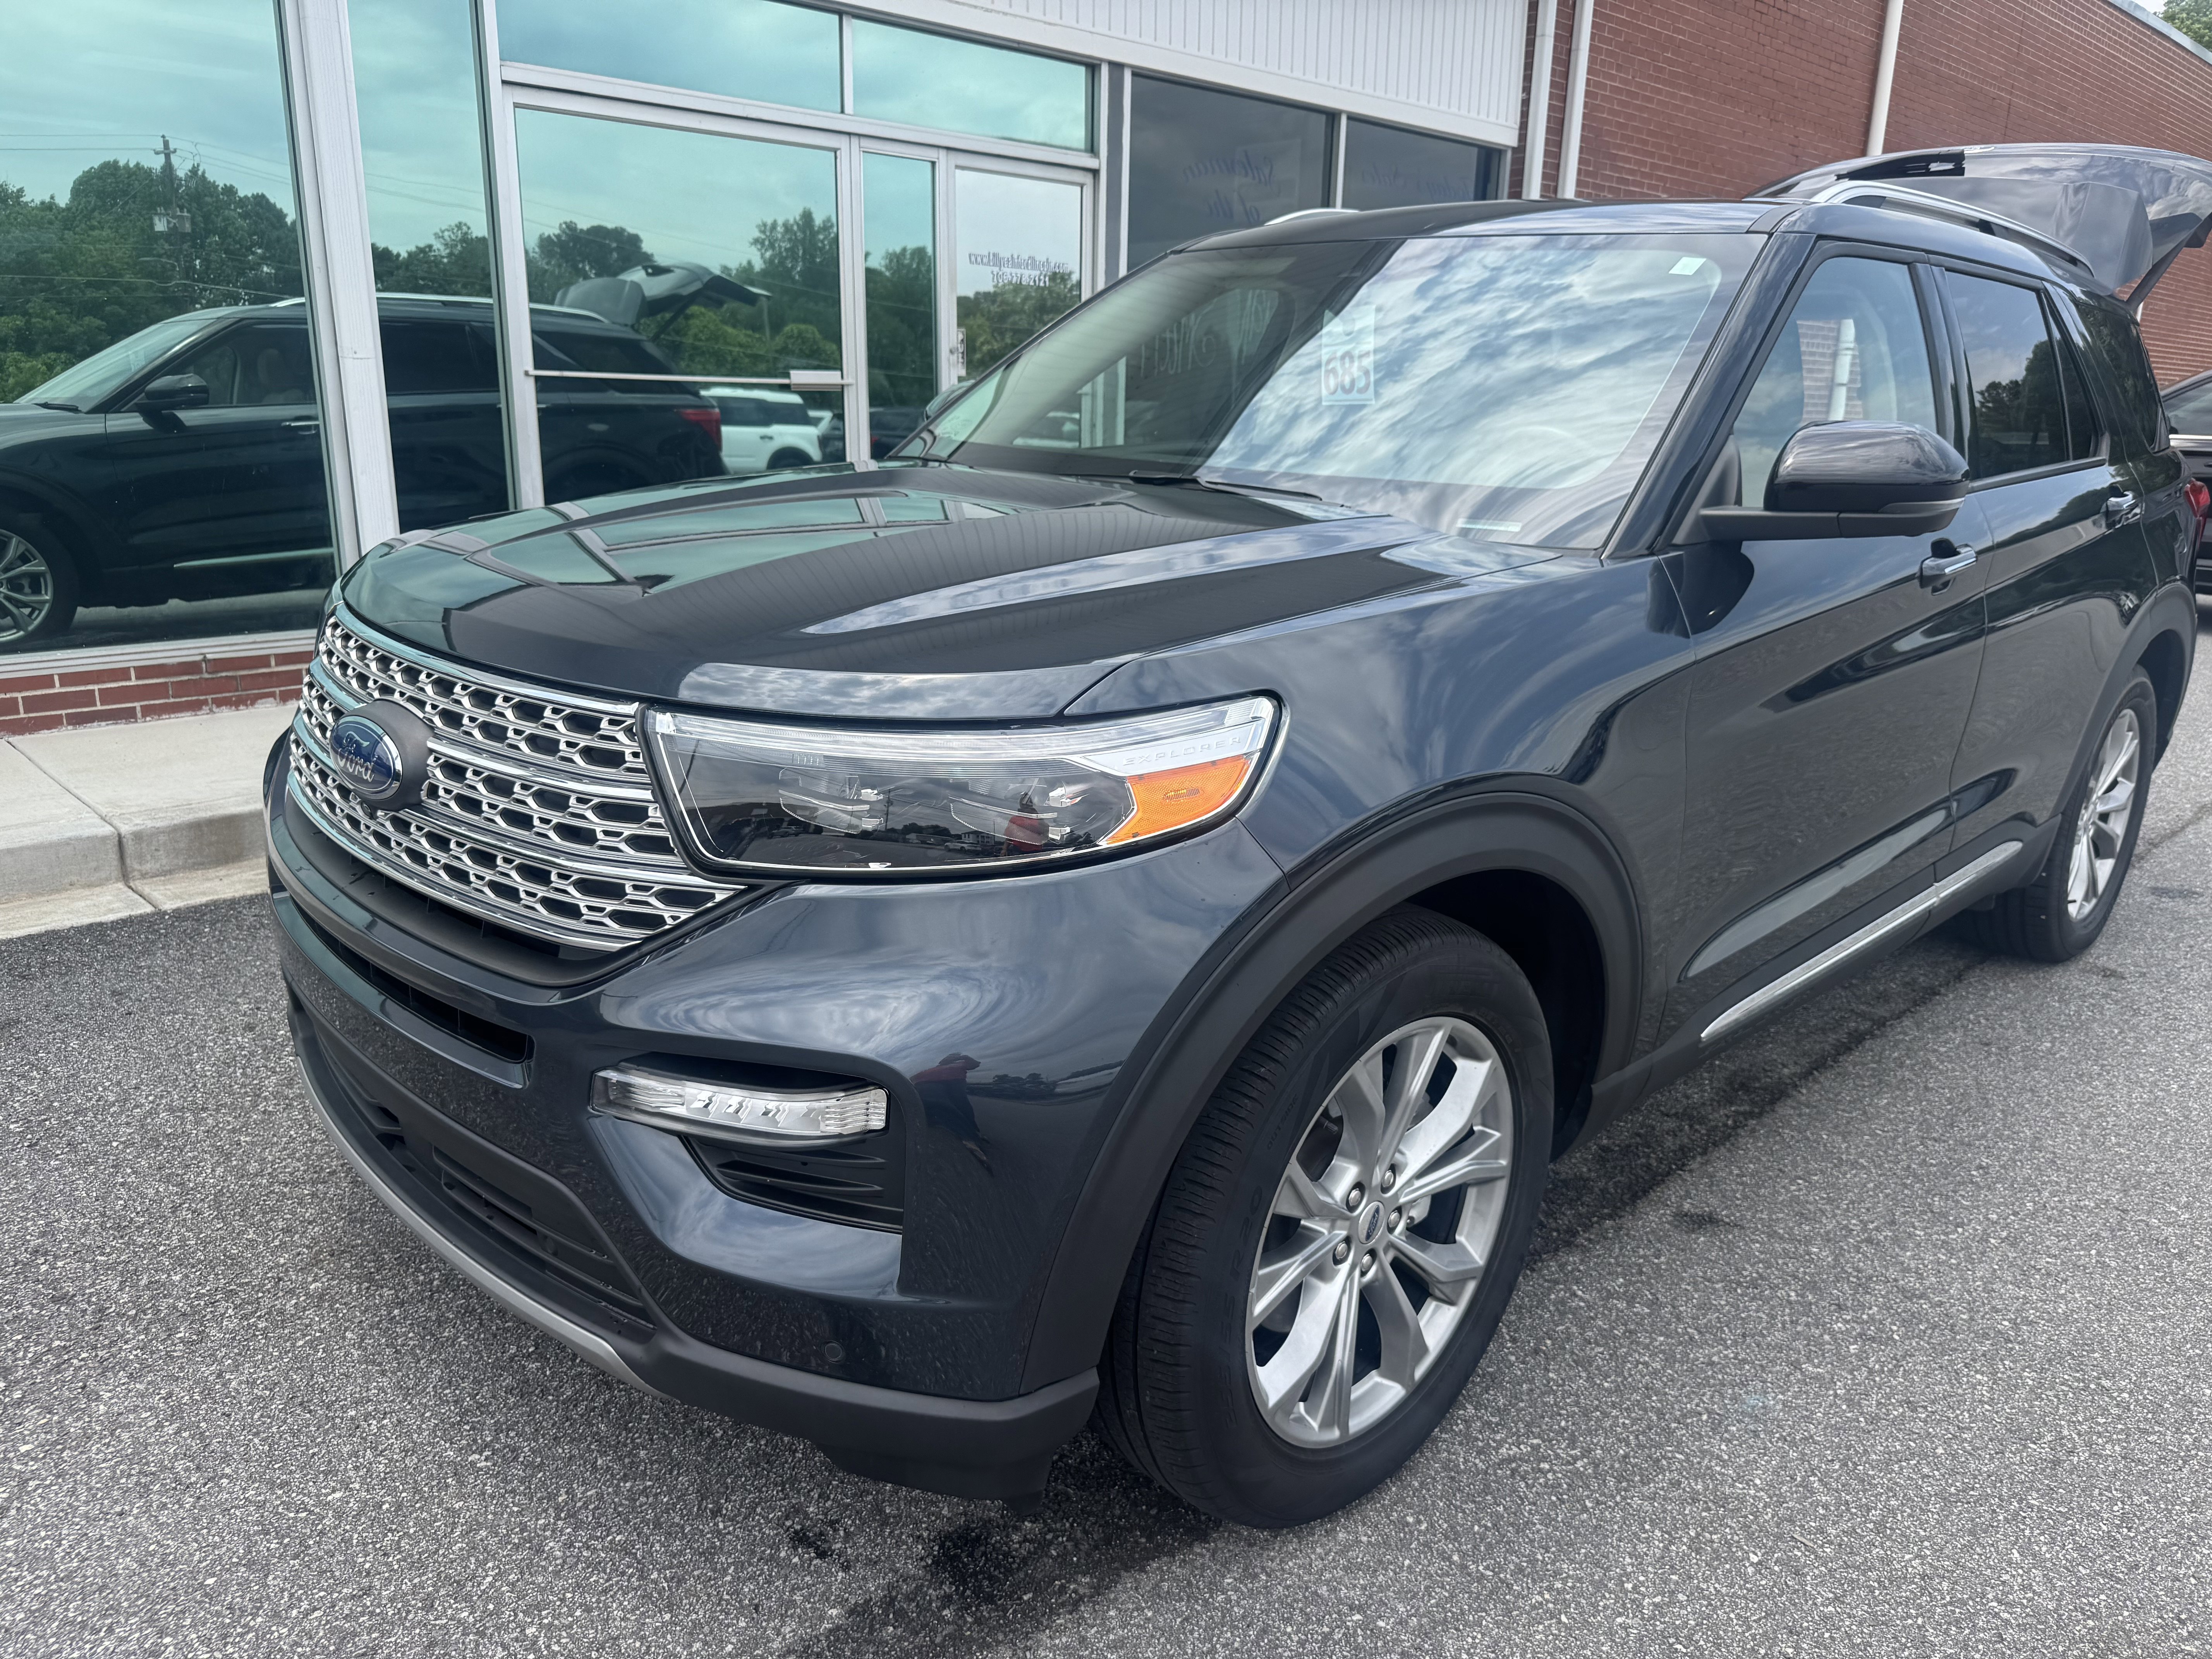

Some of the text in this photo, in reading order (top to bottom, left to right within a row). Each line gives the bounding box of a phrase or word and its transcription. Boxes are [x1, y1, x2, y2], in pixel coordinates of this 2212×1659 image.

[1323, 350, 1371, 396] 685
[337, 731, 375, 783] Ford
[1122, 737, 1241, 766] EXPLORER
[1367, 1211, 1378, 1235] Ford
